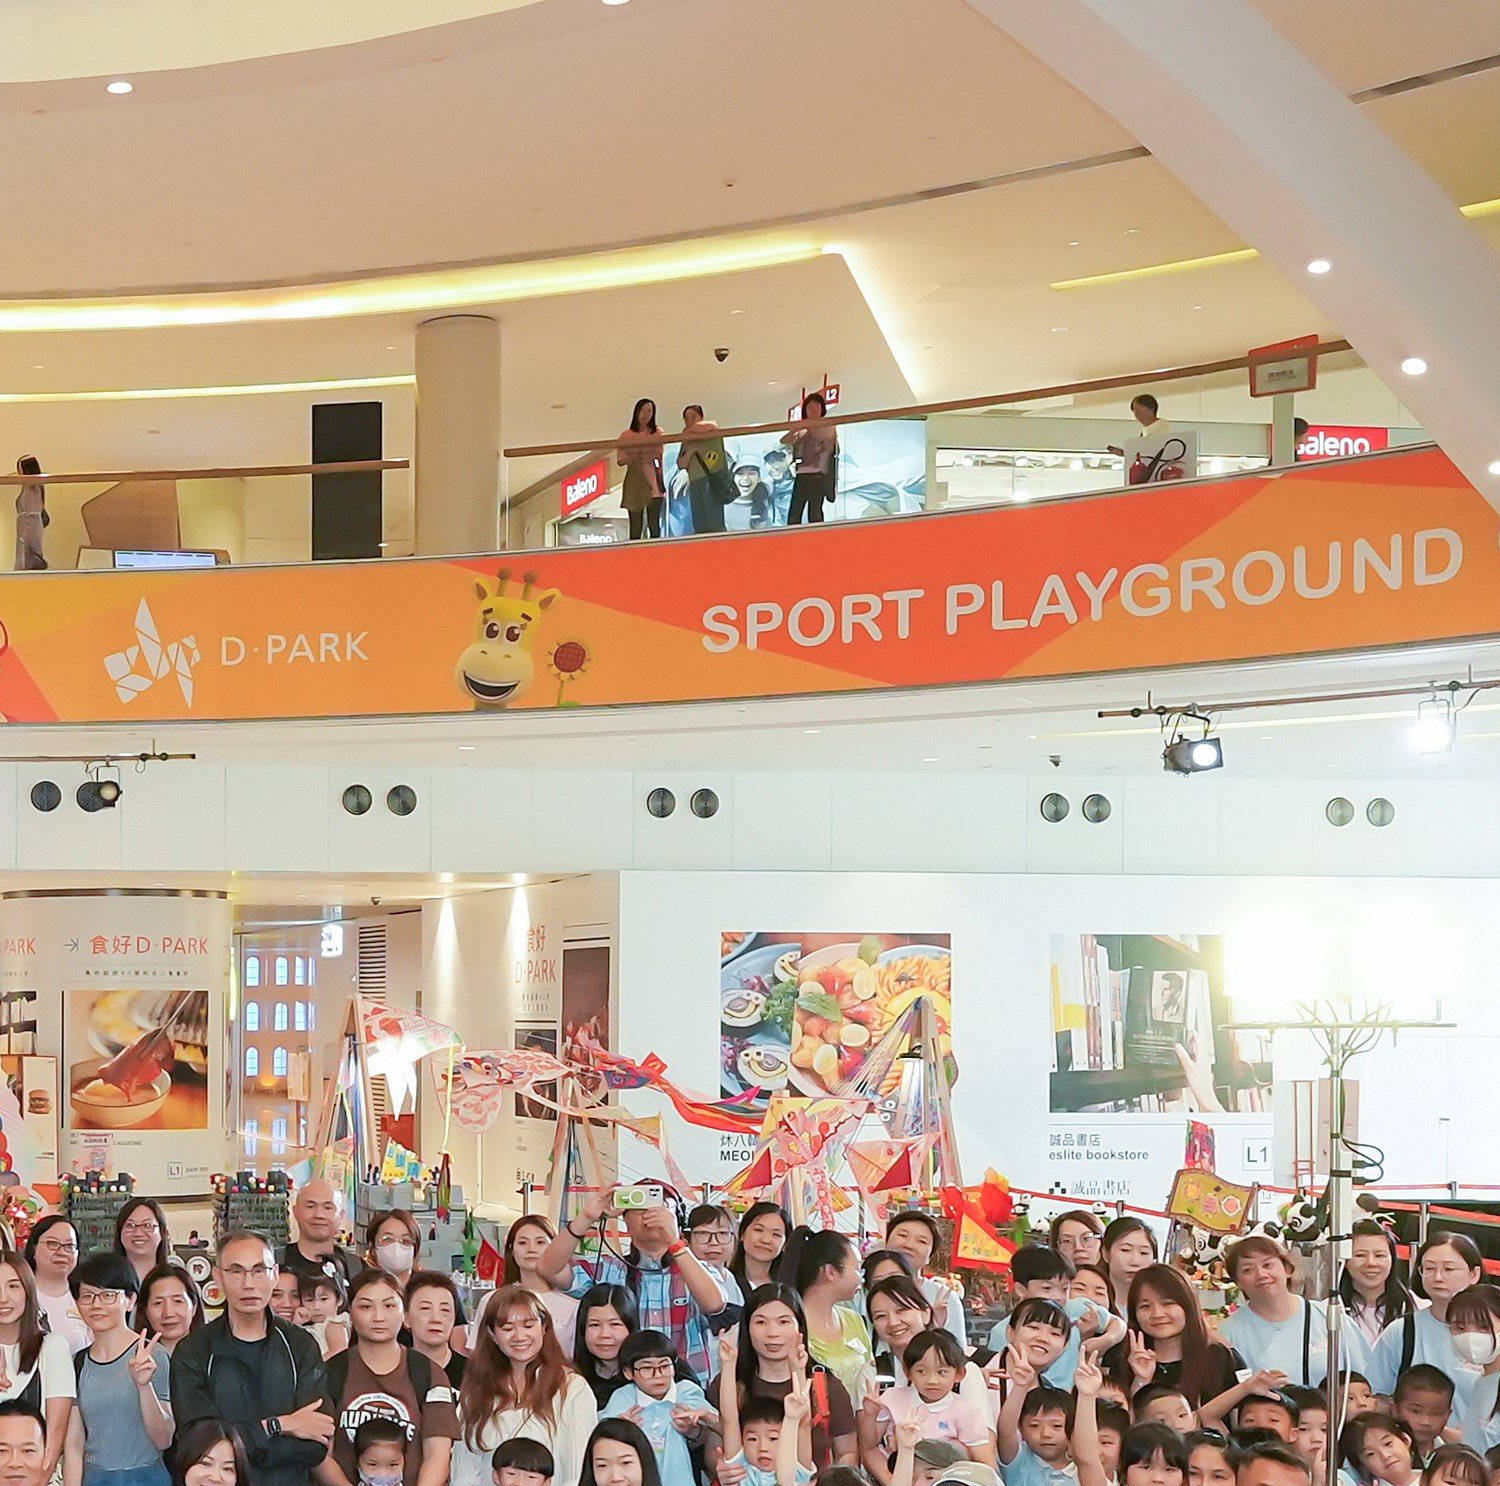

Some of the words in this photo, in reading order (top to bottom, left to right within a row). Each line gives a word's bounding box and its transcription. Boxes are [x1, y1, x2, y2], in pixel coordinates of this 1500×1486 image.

[566, 474, 598, 505] Baleno
[579, 533, 613, 544] Baleno
[702, 587, 926, 654] SPORT
[946, 526, 1465, 635] PLAYGROUND
[90, 935, 131, 955] 食好
[1049, 1133, 1101, 1147] 誠品書店
[720, 1151, 755, 1162] MEO
[1049, 1149, 1083, 1160] eslite
[1086, 1149, 1149, 1160] bookstore
[1246, 1147, 1268, 1162] L1
[169, 1166, 180, 1175] L1
[1071, 1180, 1131, 1196] 誠品書店
[340, 1411, 416, 1442] AUDE
